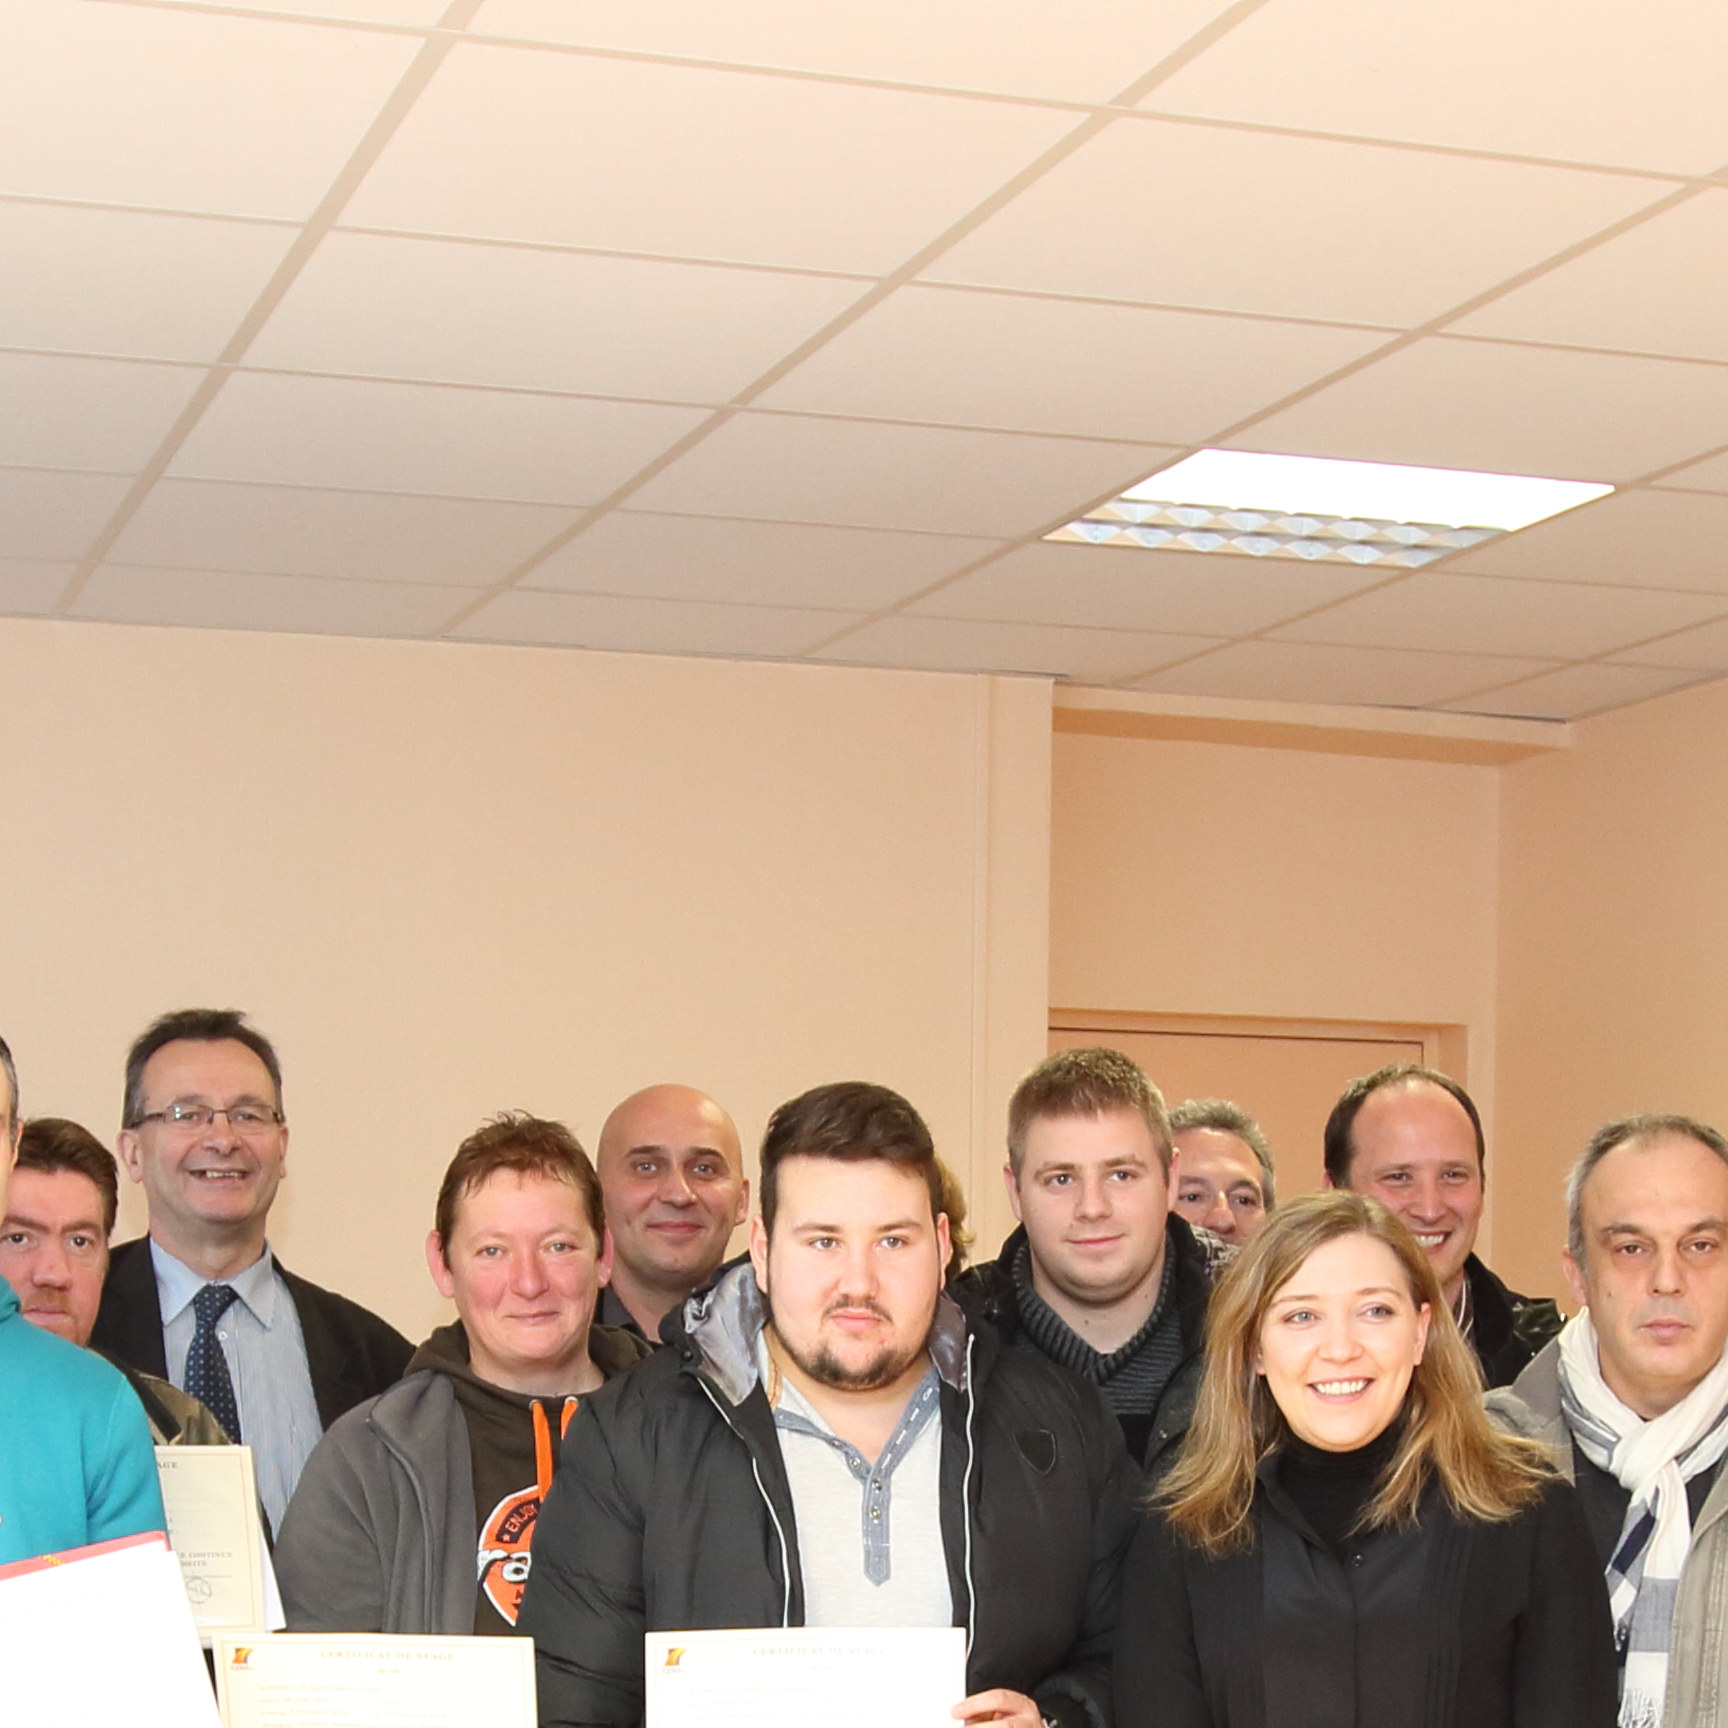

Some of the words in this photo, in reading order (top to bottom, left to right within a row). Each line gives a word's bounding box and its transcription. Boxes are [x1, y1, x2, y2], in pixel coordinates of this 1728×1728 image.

[319, 1650, 393, 1660] CERTIFICAT
[396, 1652, 413, 1660] DE
[415, 1653, 455, 1661] STAGE
